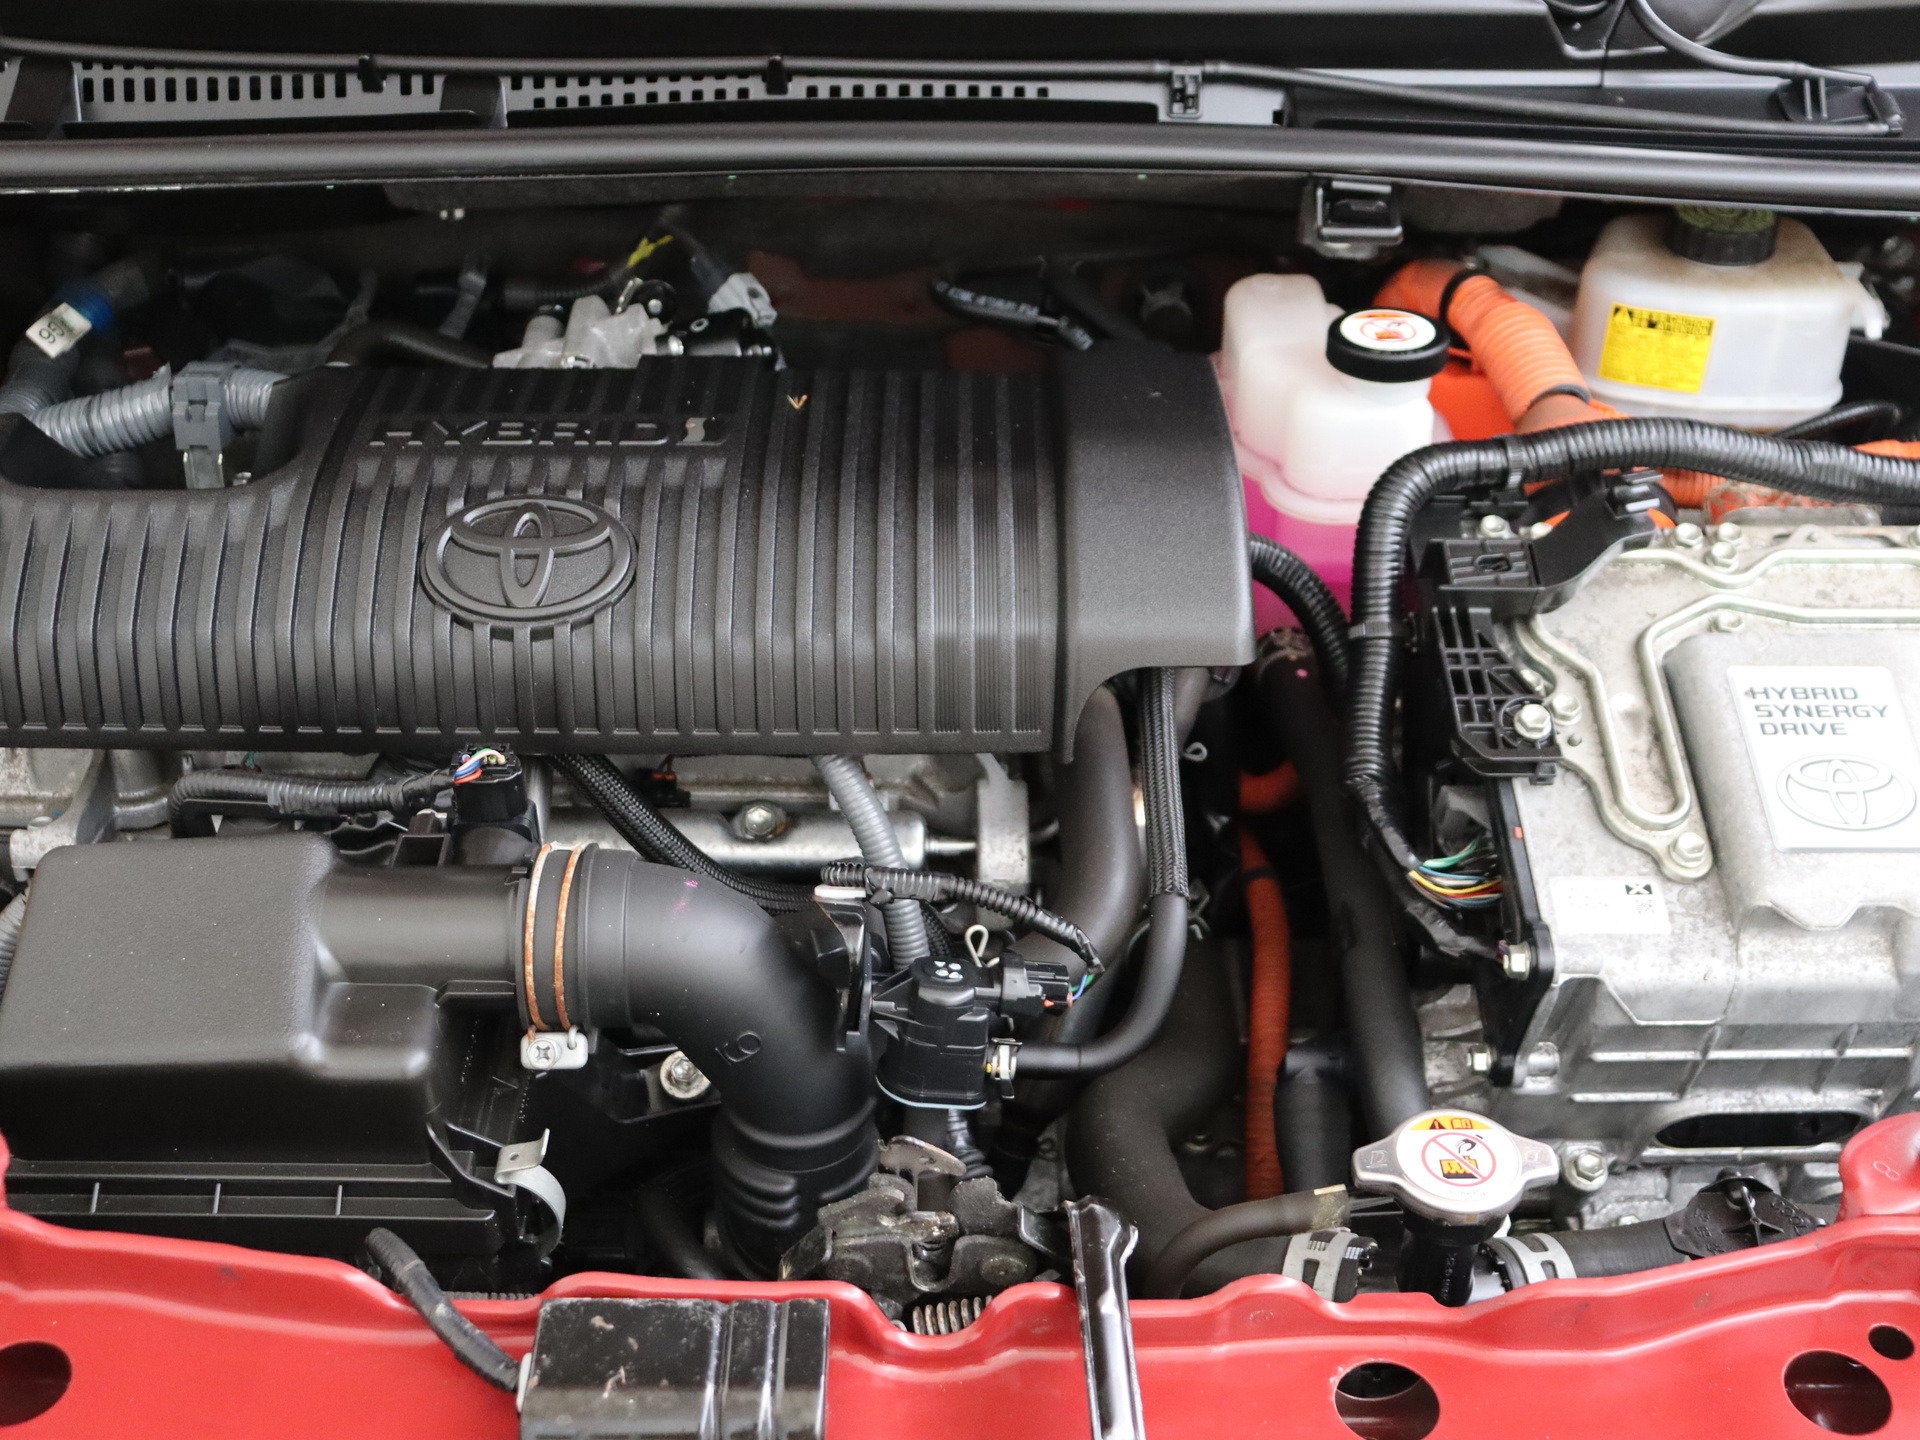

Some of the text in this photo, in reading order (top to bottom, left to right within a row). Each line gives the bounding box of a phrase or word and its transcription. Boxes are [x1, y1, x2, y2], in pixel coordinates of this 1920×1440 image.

[369, 418, 669, 446] HYBRID
[1750, 687, 1858, 700] HYBRID
[1754, 705, 1888, 718] SYNERGY
[1760, 723, 1848, 735] DRIVE
